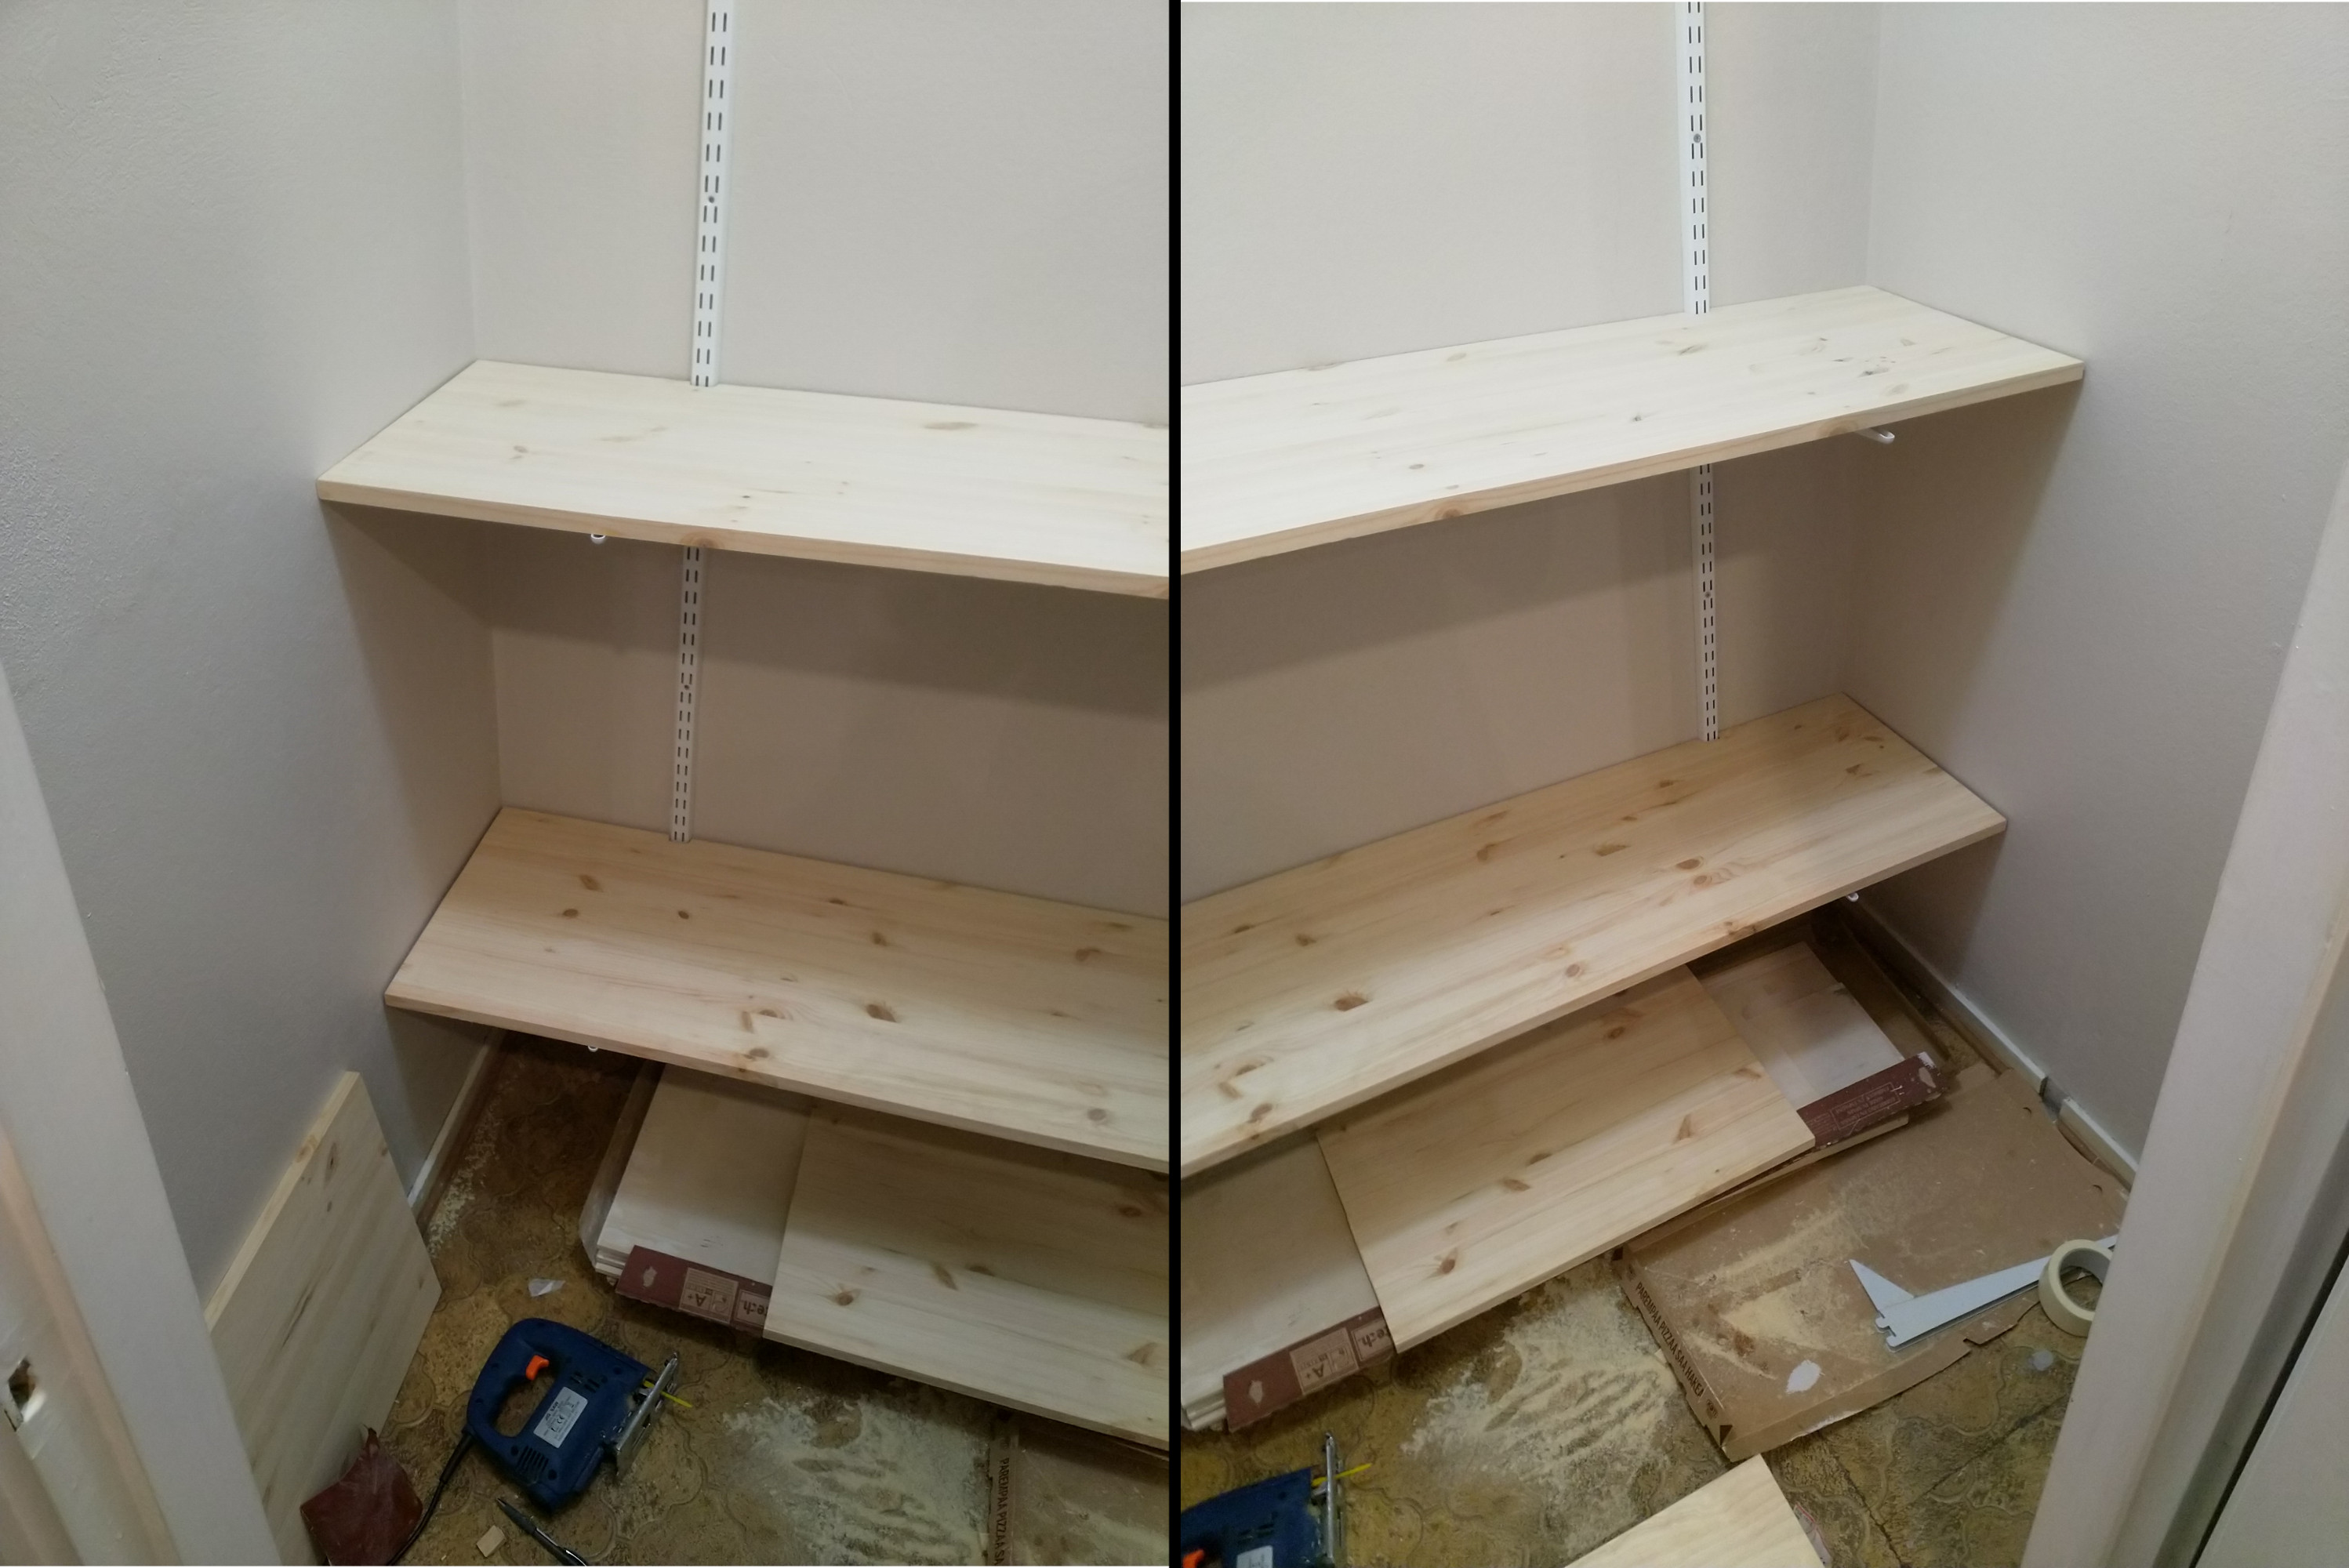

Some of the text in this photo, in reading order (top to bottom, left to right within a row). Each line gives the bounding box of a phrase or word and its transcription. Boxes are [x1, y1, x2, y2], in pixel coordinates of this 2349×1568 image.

[1636, 1282, 1661, 1326] PAREMPAA
[1658, 1321, 1677, 1353] PIZZAA
[1673, 1349, 1689, 1374] SAA
[997, 1457, 1009, 1511] PAREMPAA
[995, 1510, 1008, 1549] PIZZAA
